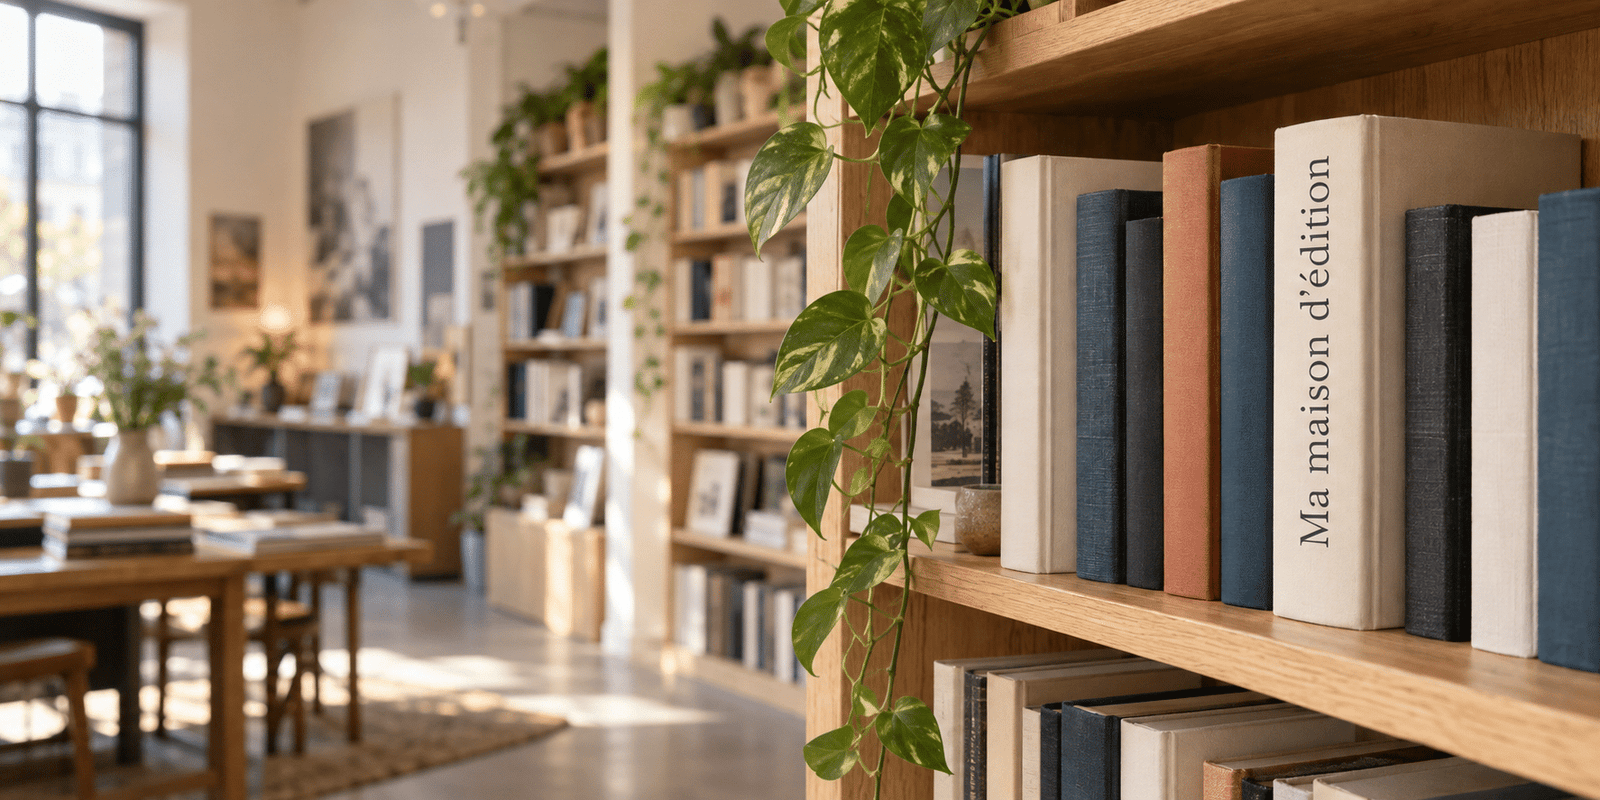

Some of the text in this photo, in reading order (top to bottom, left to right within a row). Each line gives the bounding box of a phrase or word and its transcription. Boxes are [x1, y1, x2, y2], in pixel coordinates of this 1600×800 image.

[1299, 155, 1329, 547] Ma maison d’édition
